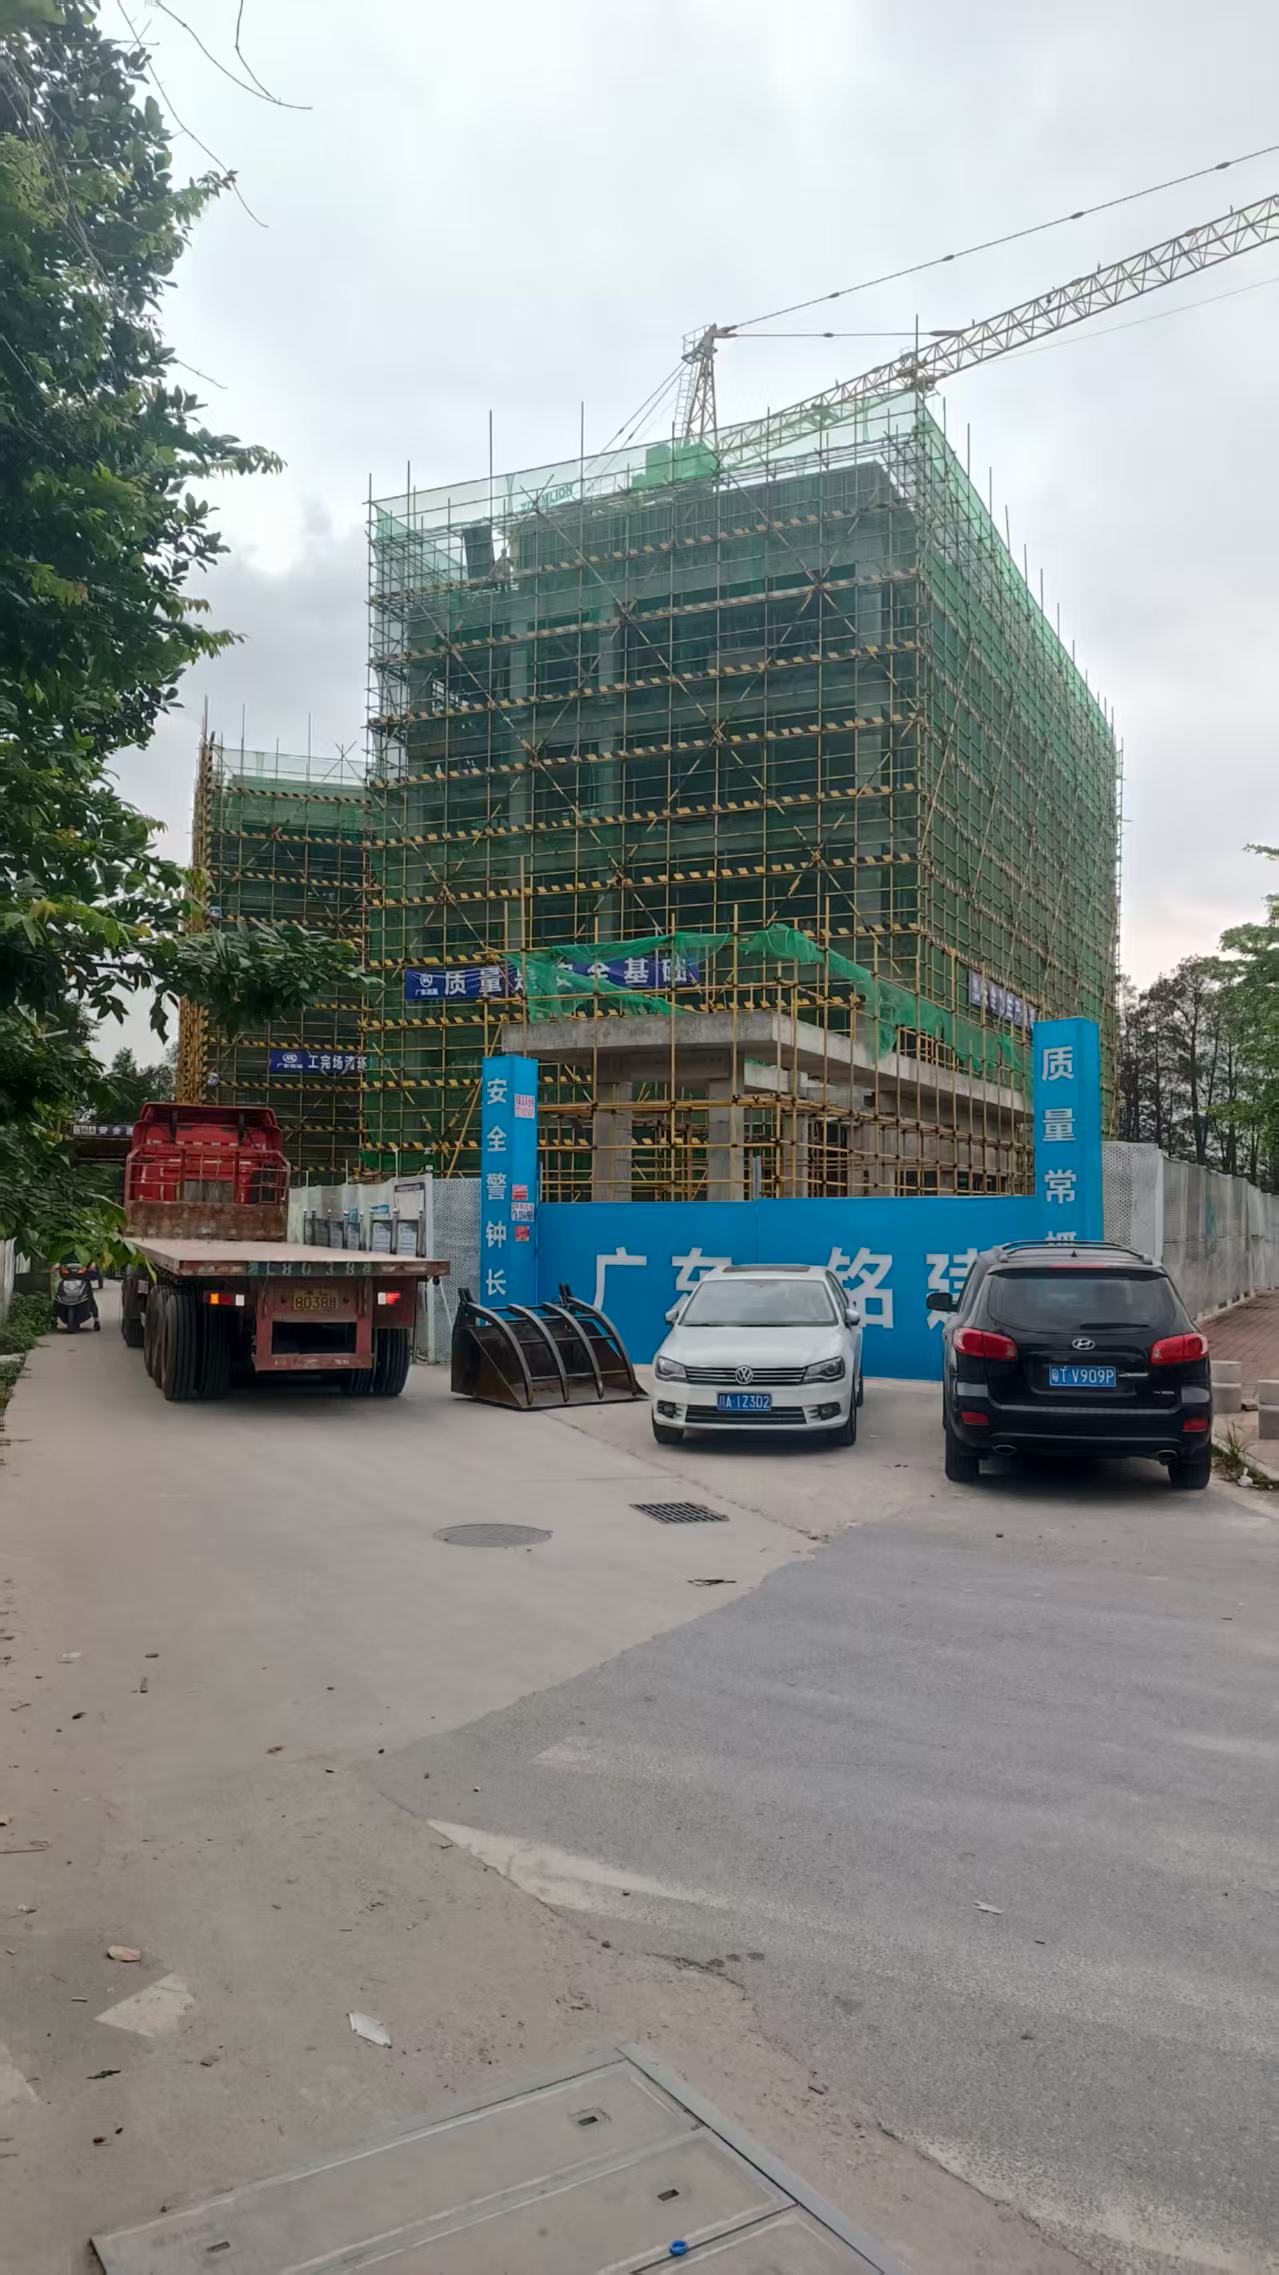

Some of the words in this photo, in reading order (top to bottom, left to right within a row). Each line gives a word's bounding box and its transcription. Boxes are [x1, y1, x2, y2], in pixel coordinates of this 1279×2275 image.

[486, 1078, 508, 1297] 安全警钟长
